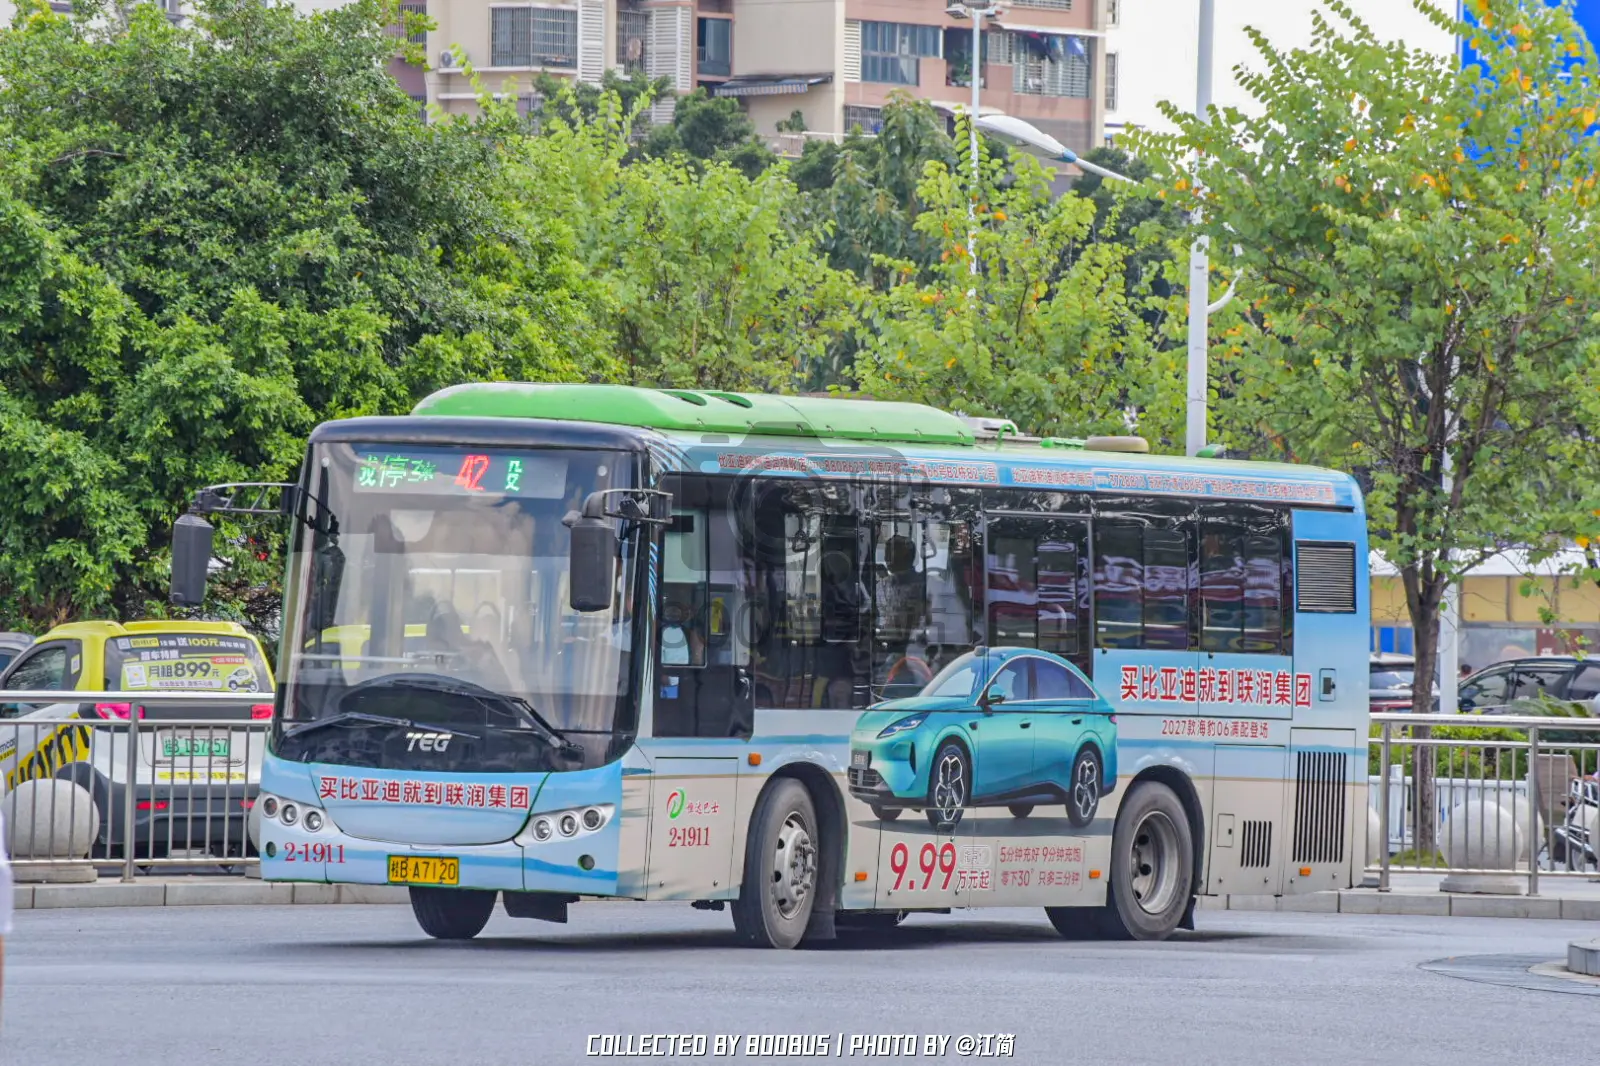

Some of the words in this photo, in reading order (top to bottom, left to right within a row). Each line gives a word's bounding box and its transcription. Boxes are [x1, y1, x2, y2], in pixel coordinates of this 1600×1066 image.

[455, 455, 491, 491] 42
[1120, 666, 1312, 707] 买比亚迪就到联润集团
[405, 733, 452, 752] TEG
[320, 776, 529, 809] 买比亚迪就到联润集团
[669, 826, 710, 847] 2-1911
[284, 842, 345, 864] 2-1911
[890, 842, 957, 891] 9.99
[957, 870, 990, 889] 万元起
